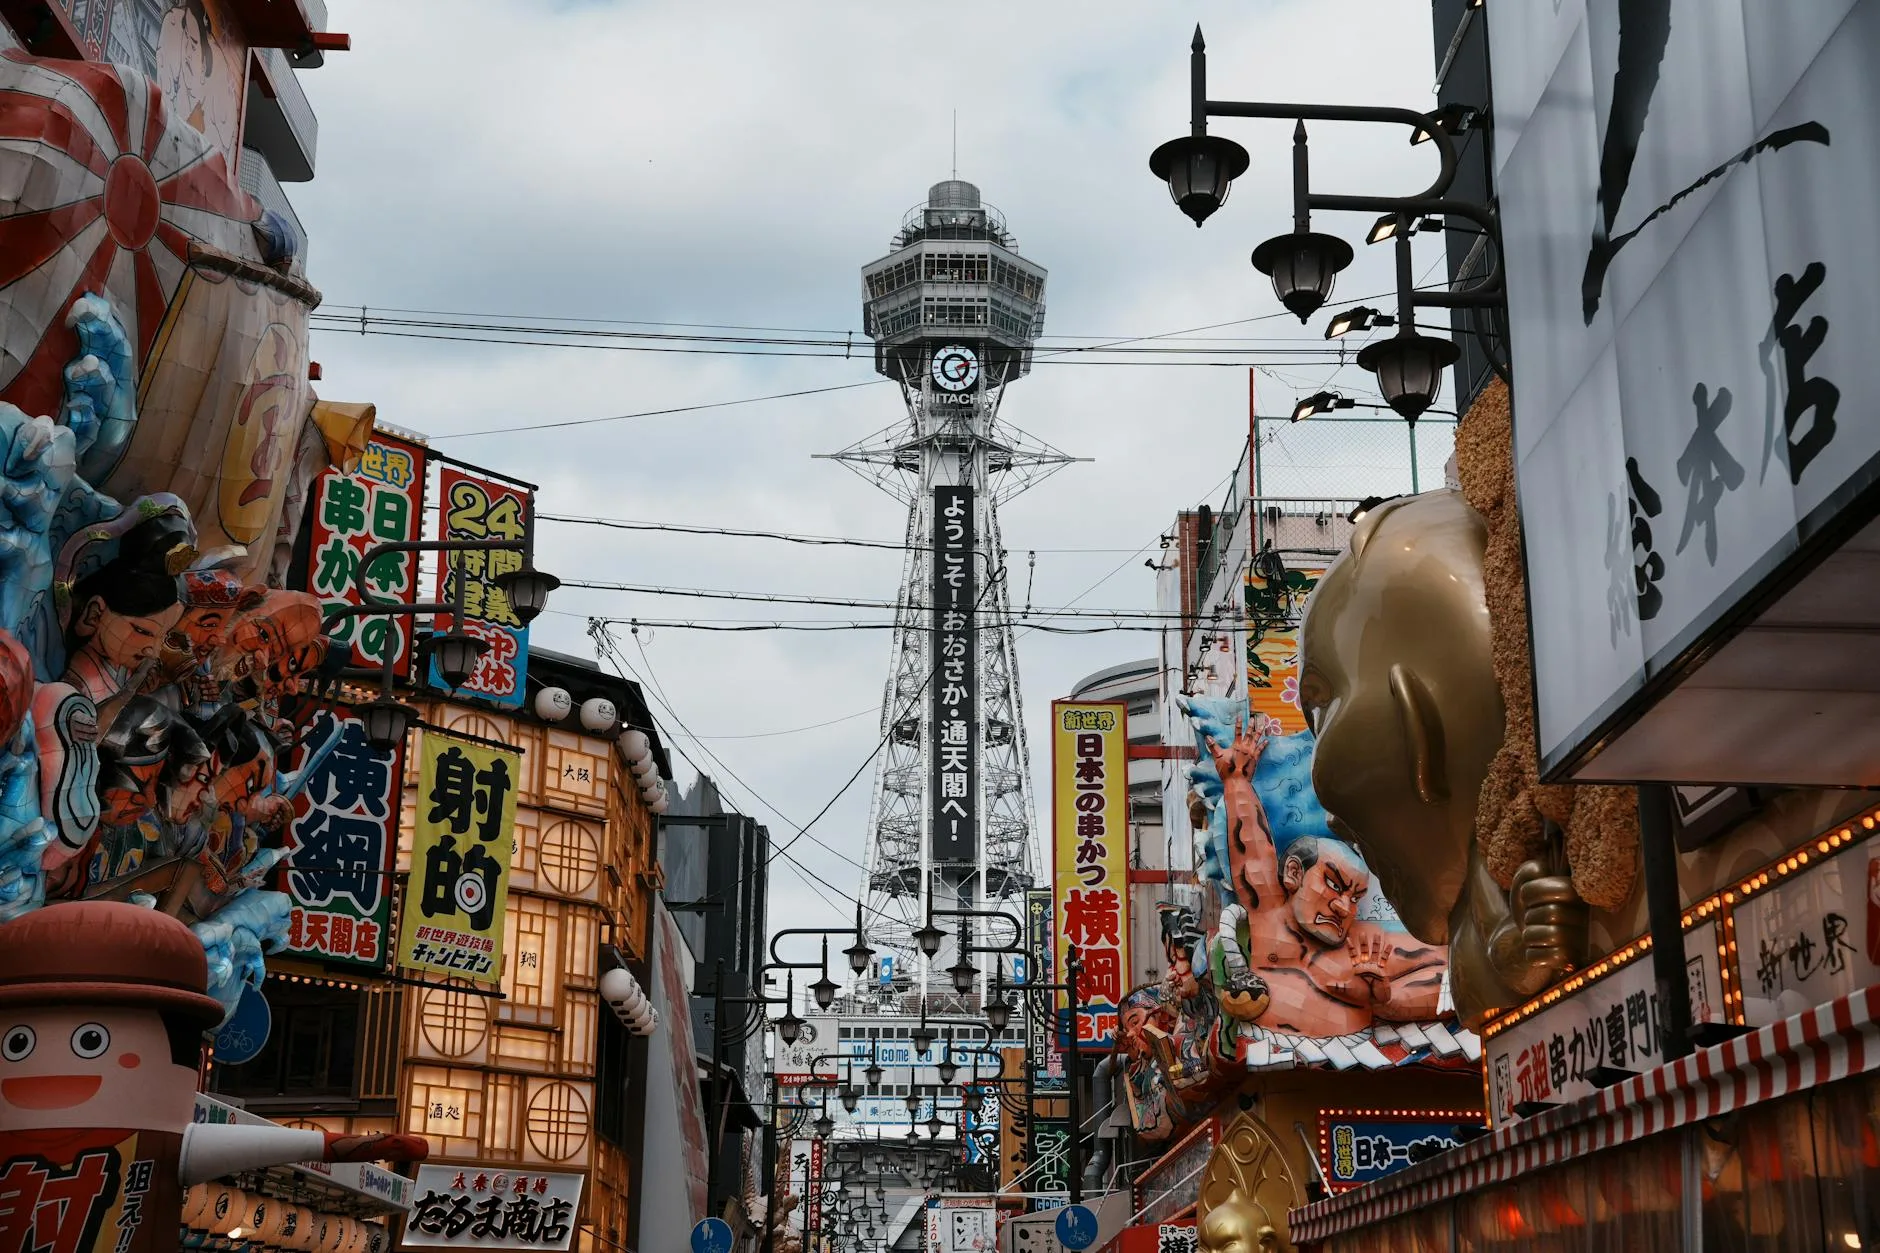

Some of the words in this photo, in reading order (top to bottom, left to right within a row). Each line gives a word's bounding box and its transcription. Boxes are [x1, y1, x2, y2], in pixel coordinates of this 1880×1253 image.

[926, 393, 983, 404] HITACH
[357, 447, 411, 488] 世界
[449, 482, 525, 544] 24
[1063, 710, 1115, 731] 新世界
[563, 764, 592, 784] 大阪
[1075, 733, 1107, 886] 日本一の串かつ
[415, 926, 495, 954] 新世界遊技場
[1063, 888, 1121, 1006] 横綱
[1757, 912, 1858, 998] 新世界
[411, 943, 494, 975] チャンピオン
[943, 1045, 1004, 1063] OSAK
[429, 1101, 462, 1122] 酒処
[1335, 1127, 1355, 1178] 新世界
[514, 1175, 550, 1195] 酒場
[408, 1190, 574, 1244] だるま商店
